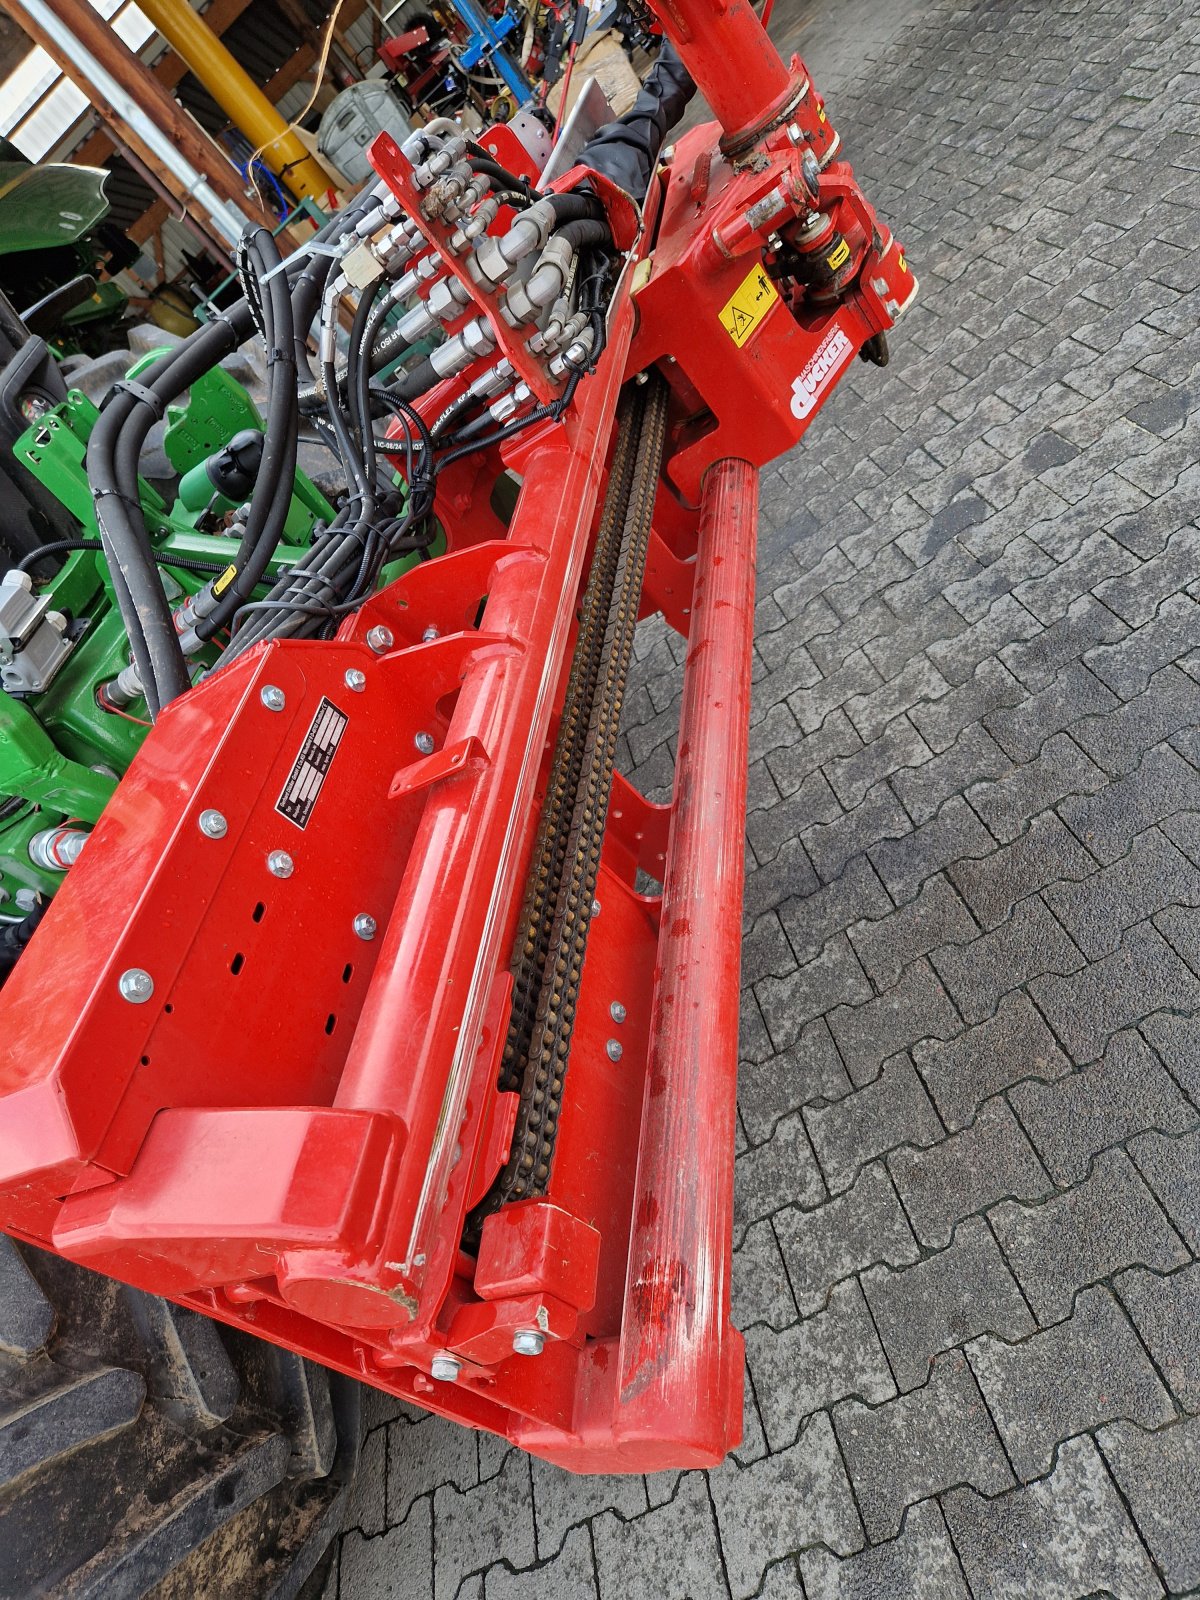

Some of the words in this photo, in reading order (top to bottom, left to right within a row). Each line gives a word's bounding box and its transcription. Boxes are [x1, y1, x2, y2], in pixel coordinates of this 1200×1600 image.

[358, 309, 379, 356] HANSA-FLEX
[380, 335, 394, 349] ISO
[799, 321, 840, 381] MASCHINENFABRIK
[430, 404, 455, 437] NSA-FLEX
[457, 393, 466, 404] KP
